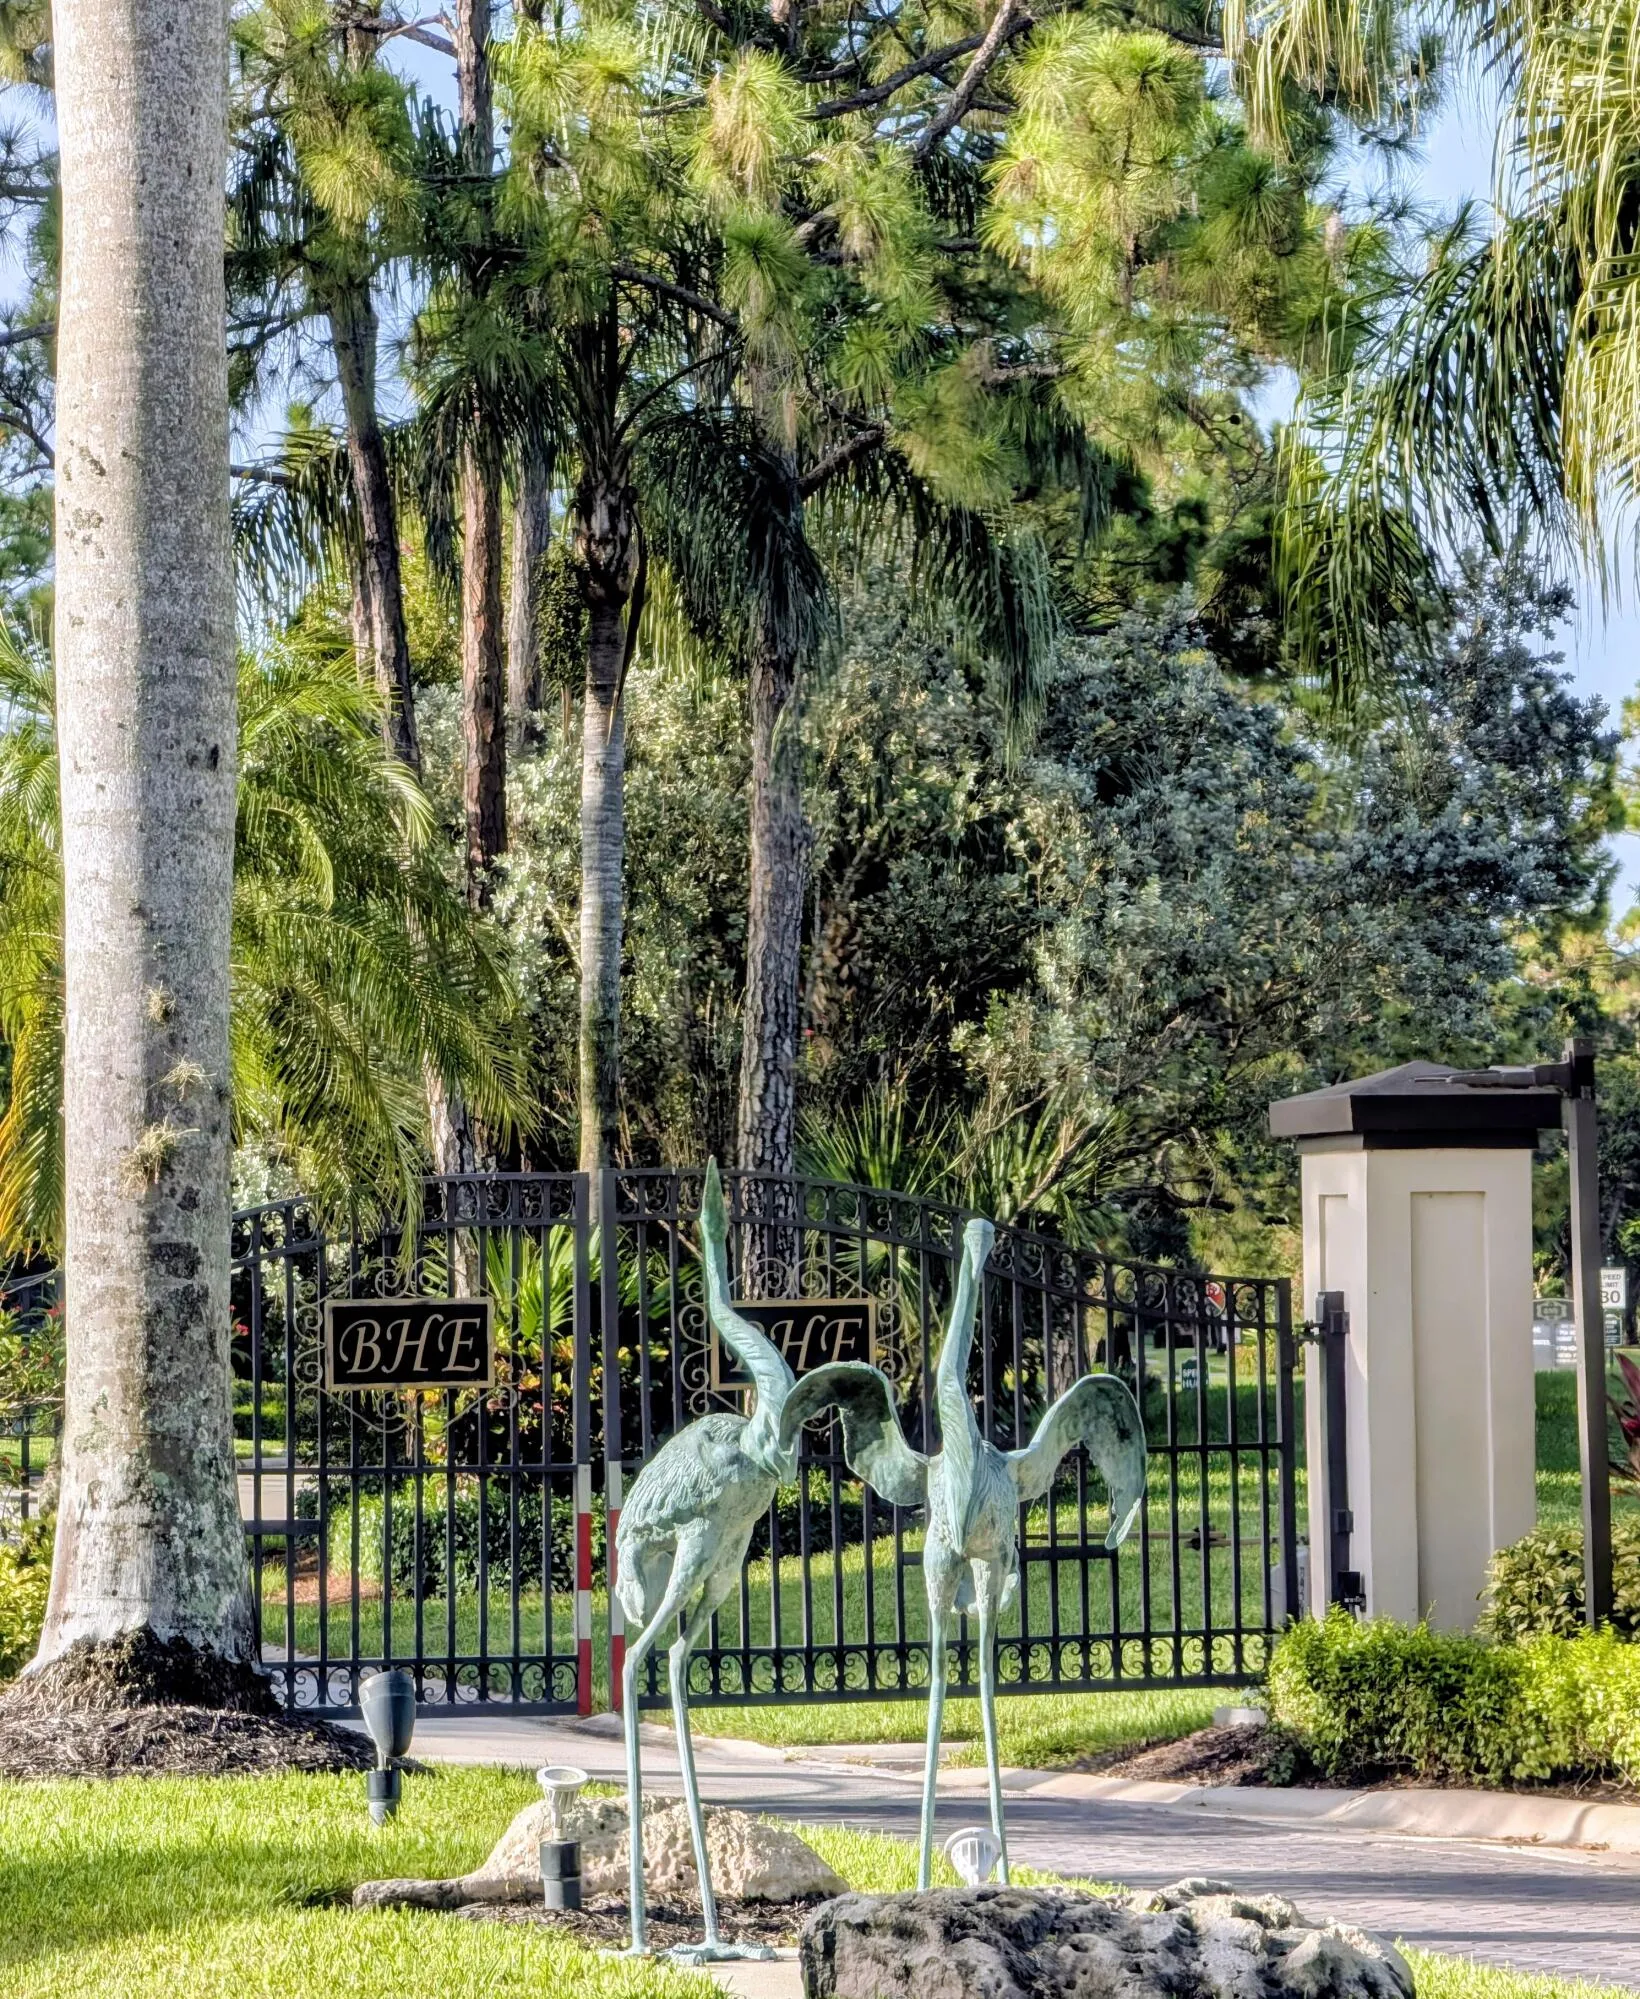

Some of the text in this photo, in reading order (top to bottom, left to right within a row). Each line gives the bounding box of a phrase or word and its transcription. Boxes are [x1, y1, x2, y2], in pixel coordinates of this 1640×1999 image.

[1600, 1290, 1621, 1304] 30
[339, 1313, 481, 1374] BHE
[724, 1314, 863, 1373] HE
